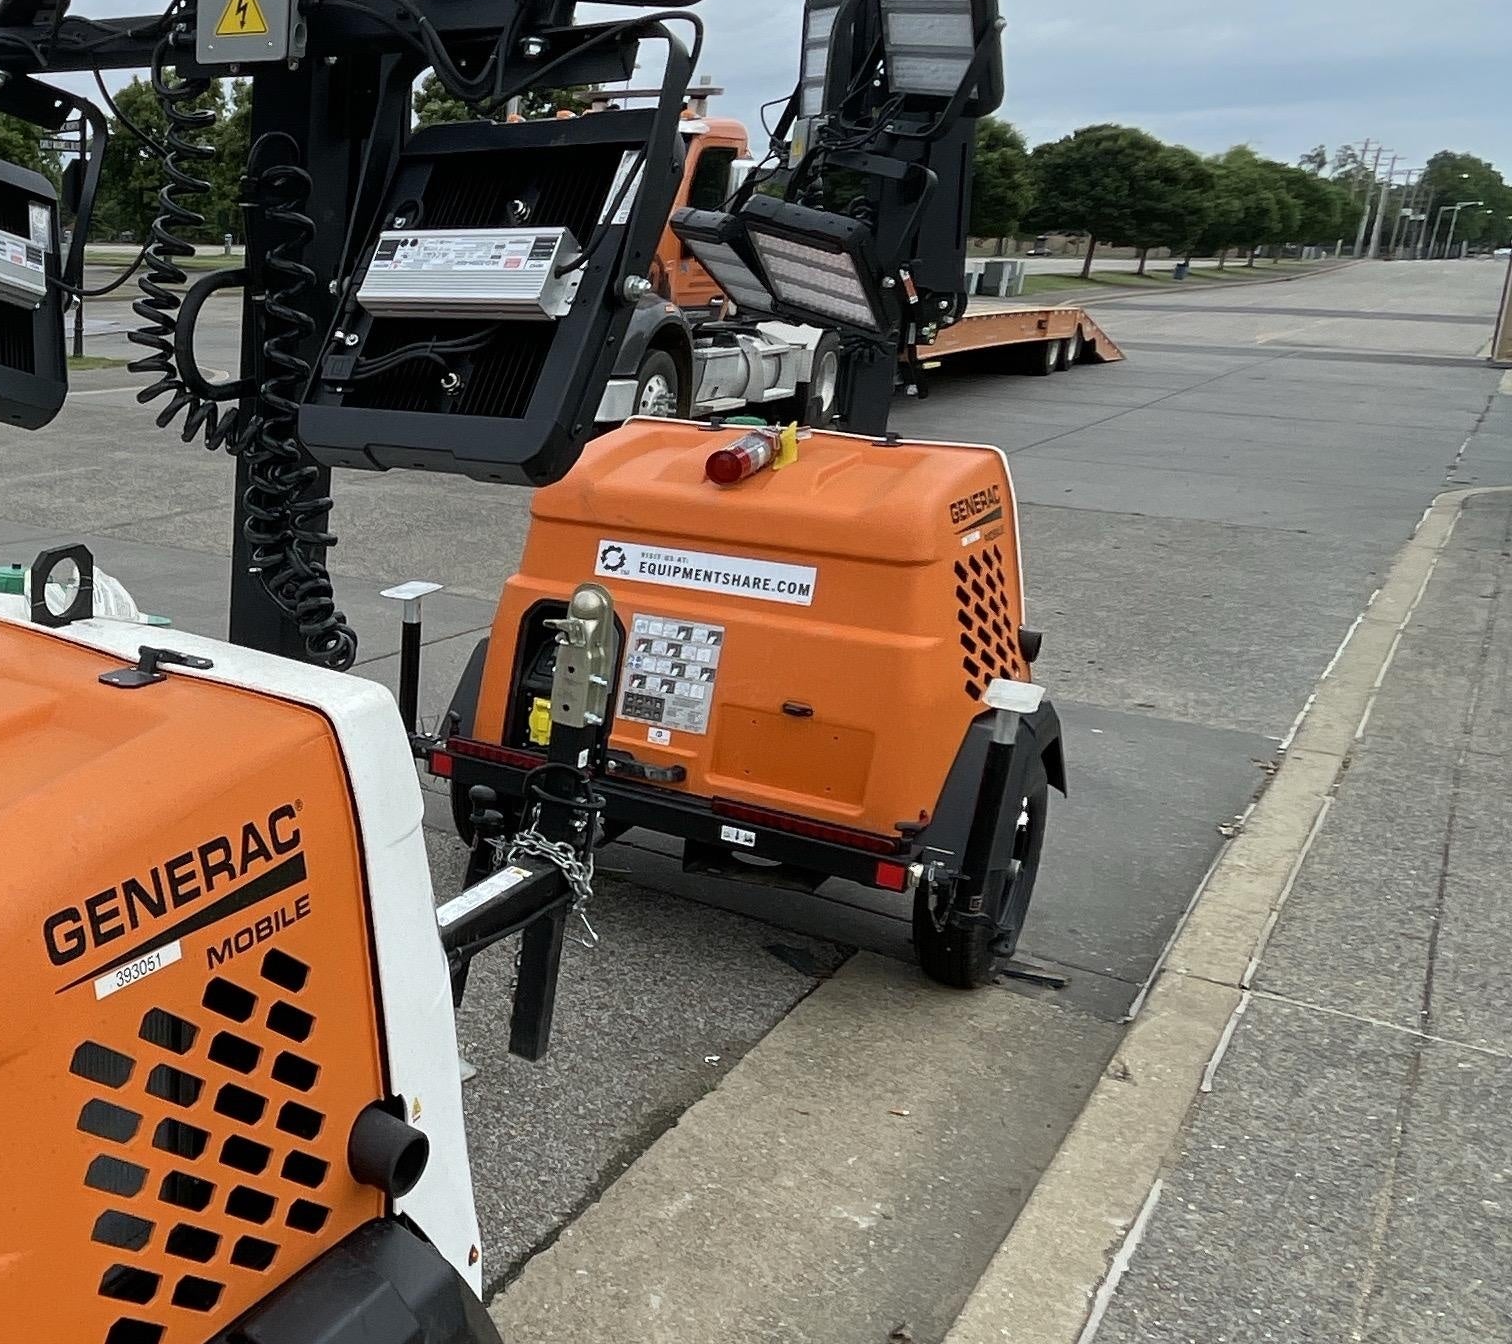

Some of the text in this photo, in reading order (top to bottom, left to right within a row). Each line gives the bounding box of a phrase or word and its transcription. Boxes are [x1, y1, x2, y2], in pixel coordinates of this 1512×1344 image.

[638, 561, 812, 597] EQUIPMENTSHARE.COM
[42, 803, 303, 967] GENERAC
[205, 892, 312, 971] MOBILE
[115, 952, 164, 988] 393051
